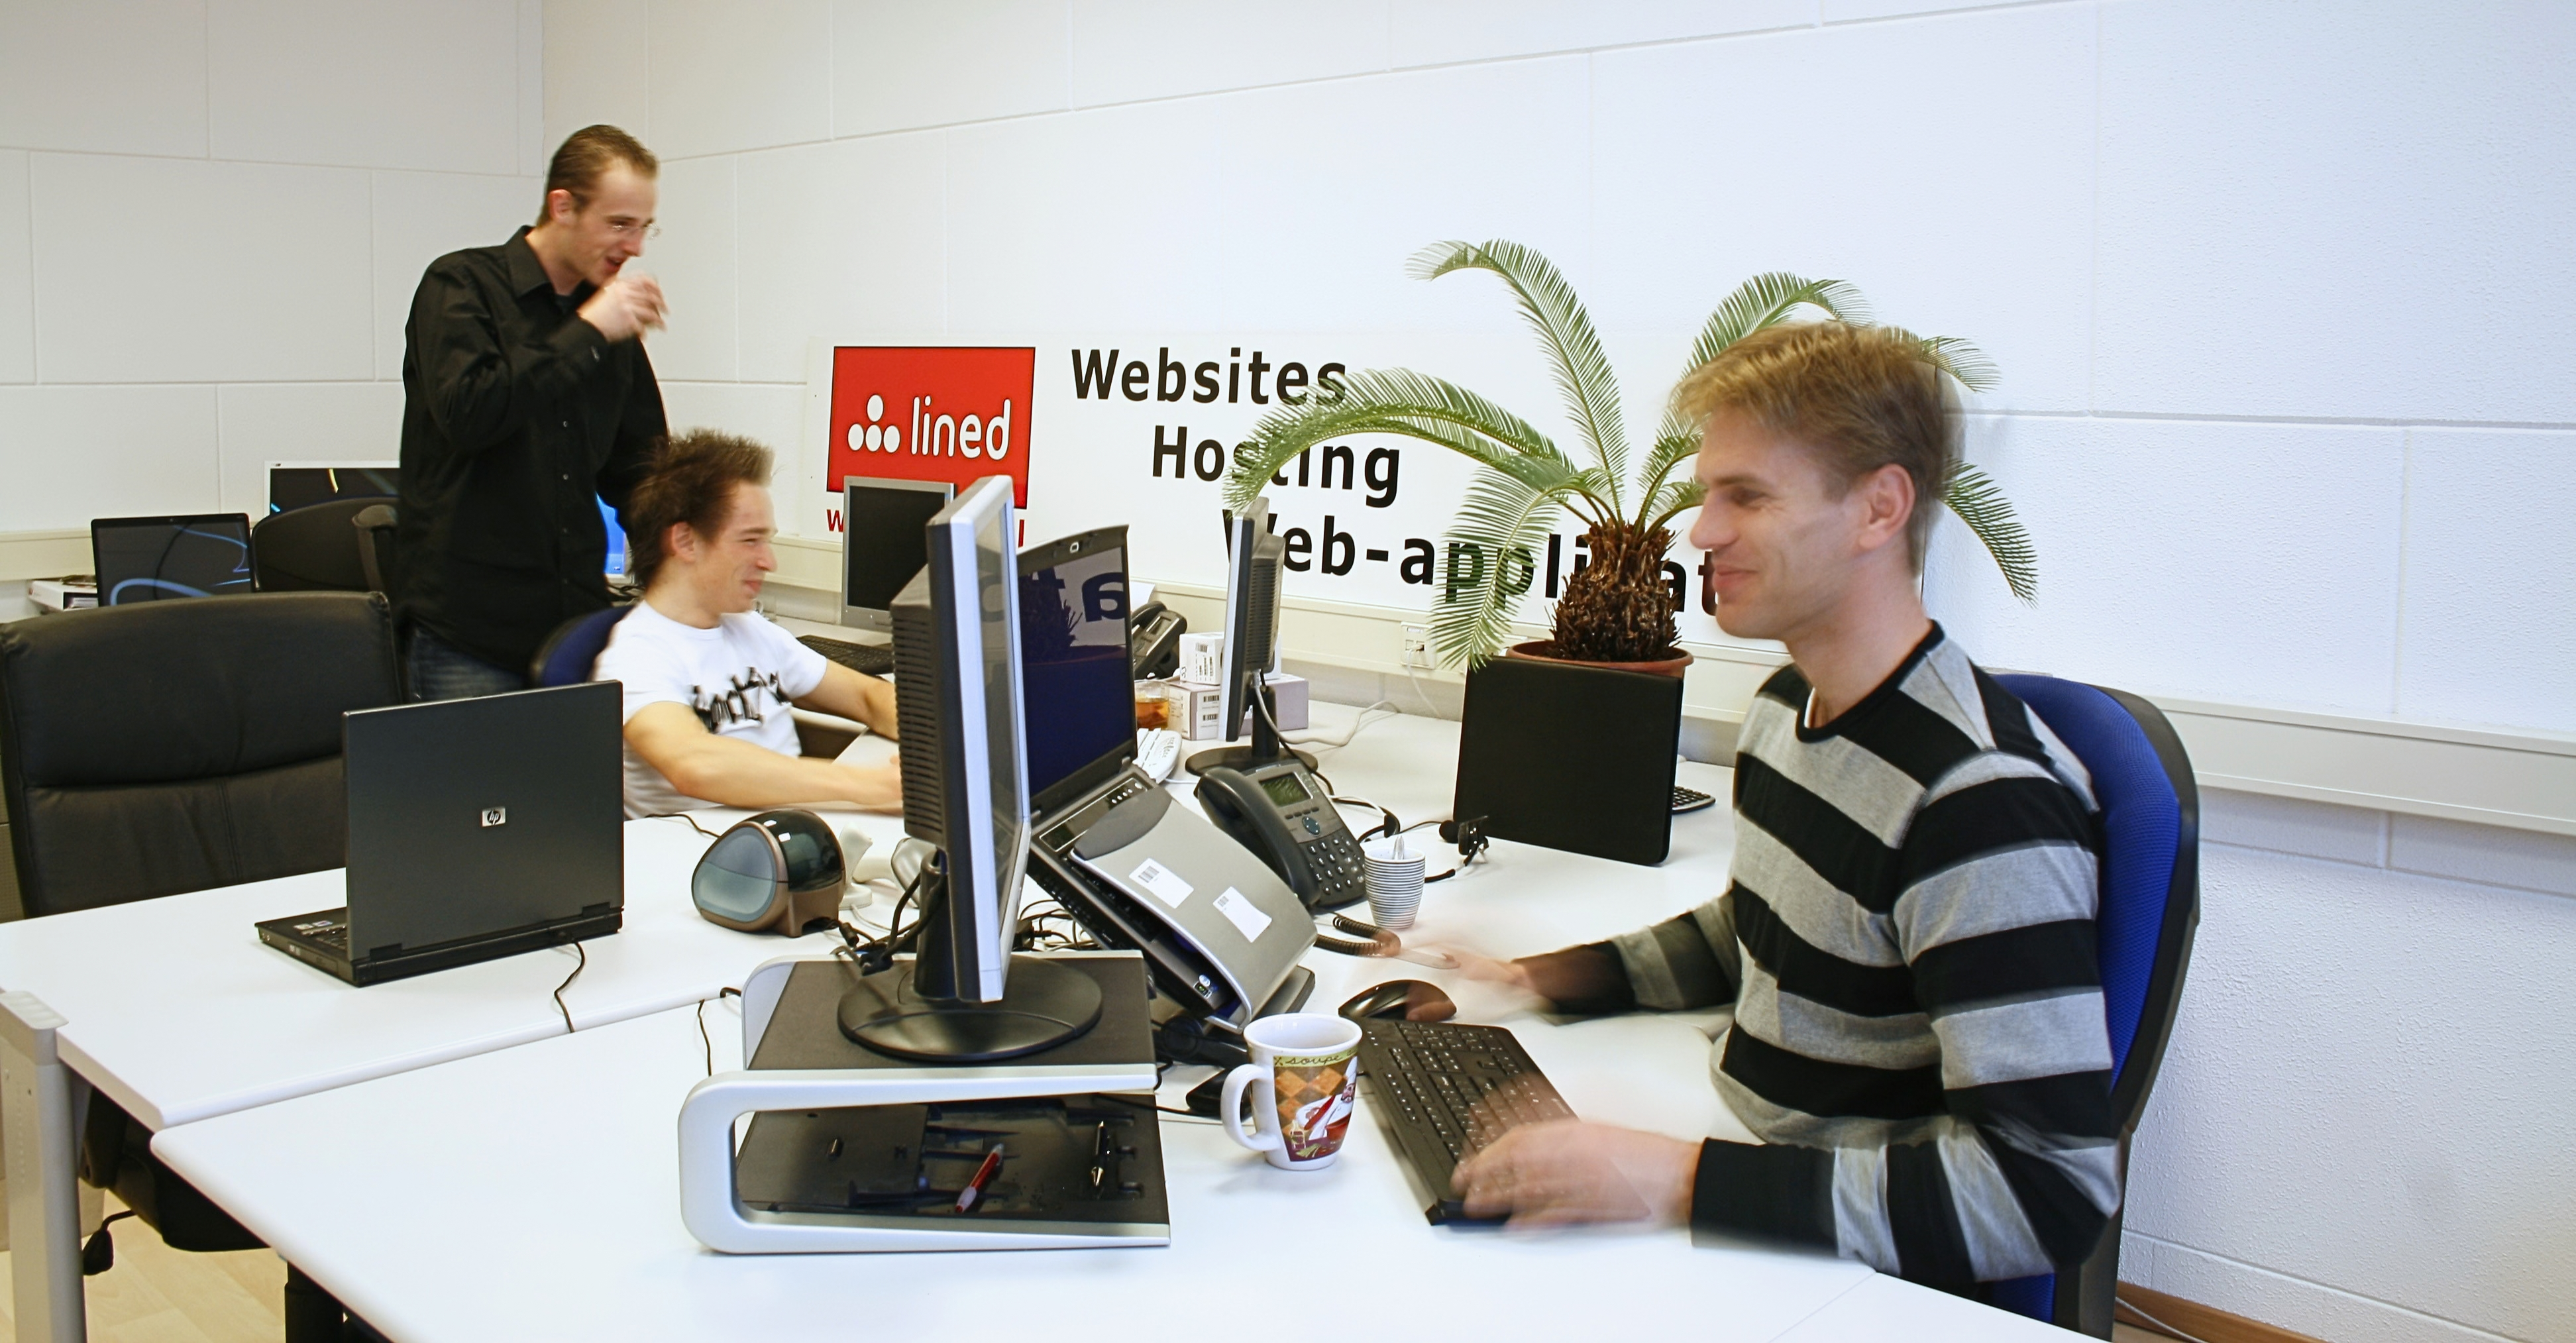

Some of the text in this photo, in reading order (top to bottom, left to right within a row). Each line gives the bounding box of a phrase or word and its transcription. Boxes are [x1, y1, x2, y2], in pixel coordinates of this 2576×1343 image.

[1072, 347, 1346, 405] Websites
[910, 396, 1011, 460] lined
[1222, 509, 1718, 616] eb-appliat
